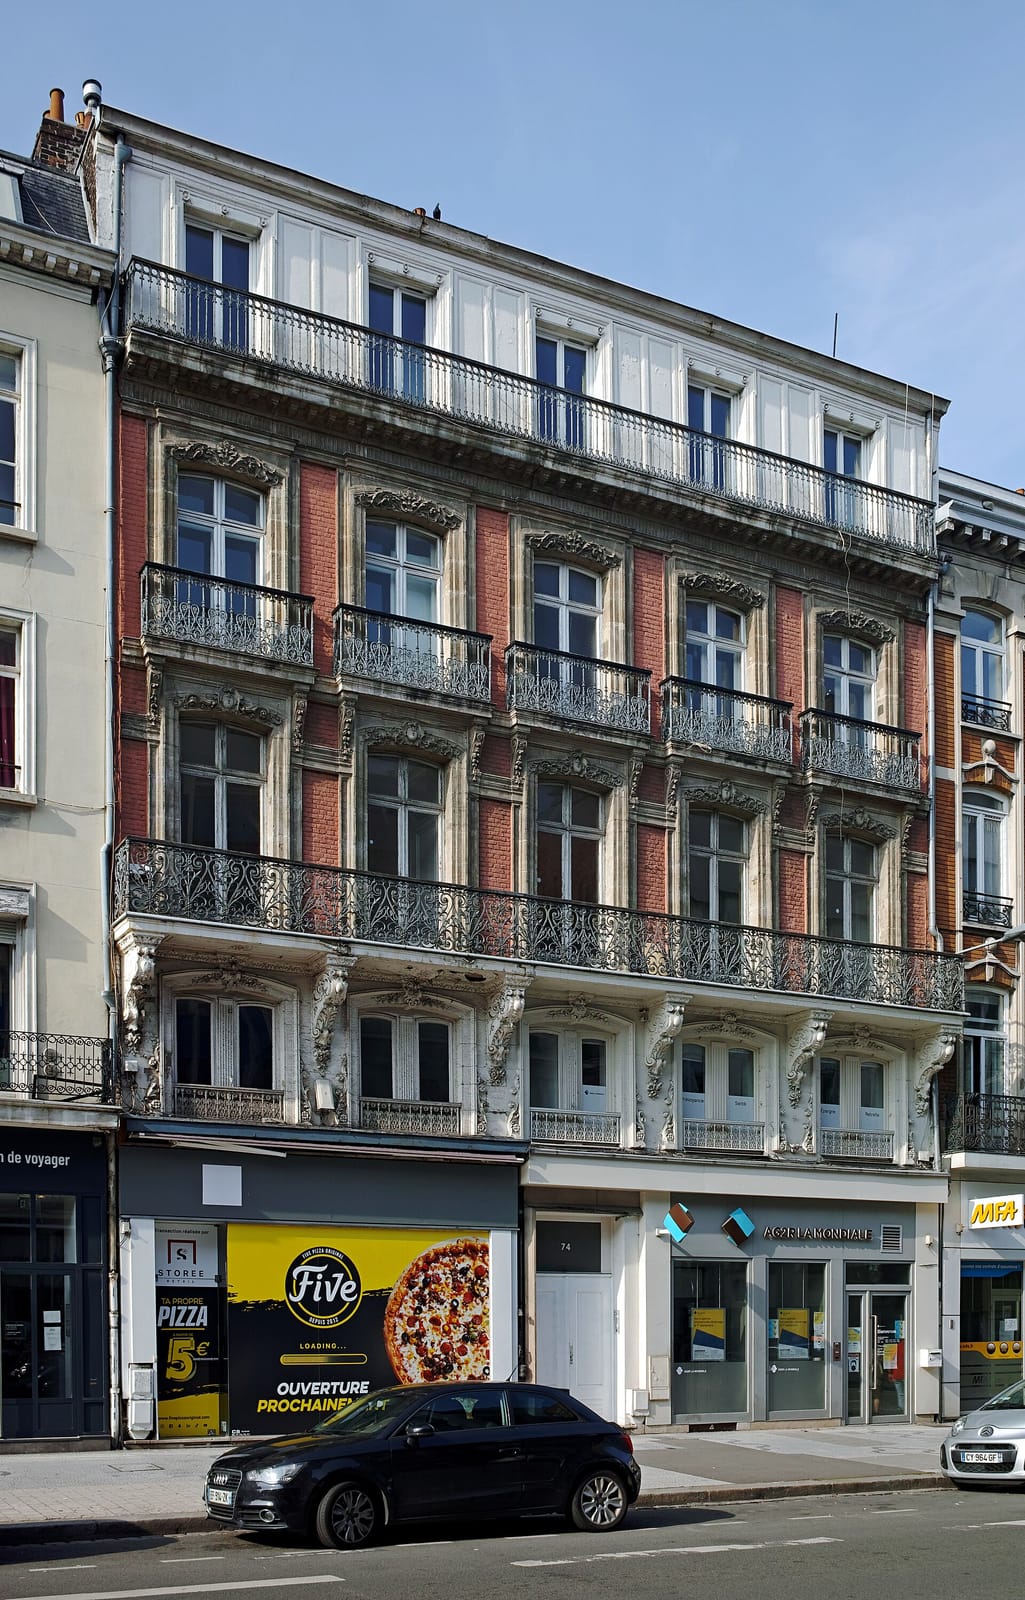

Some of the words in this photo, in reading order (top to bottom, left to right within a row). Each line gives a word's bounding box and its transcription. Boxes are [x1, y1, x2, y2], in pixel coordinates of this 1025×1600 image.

[7, 1151, 22, 1164] de
[25, 1154, 70, 1168] voyager
[970, 1201, 1019, 1224] MFA
[813, 1228, 873, 1240] MONDIALE
[560, 1242, 571, 1251] 74
[158, 1269, 204, 1278] STOREE
[157, 1305, 208, 1327] PIZZA
[309, 1317, 326, 1325] DEPUIS
[277, 1381, 370, 1396] OUVERTURE
